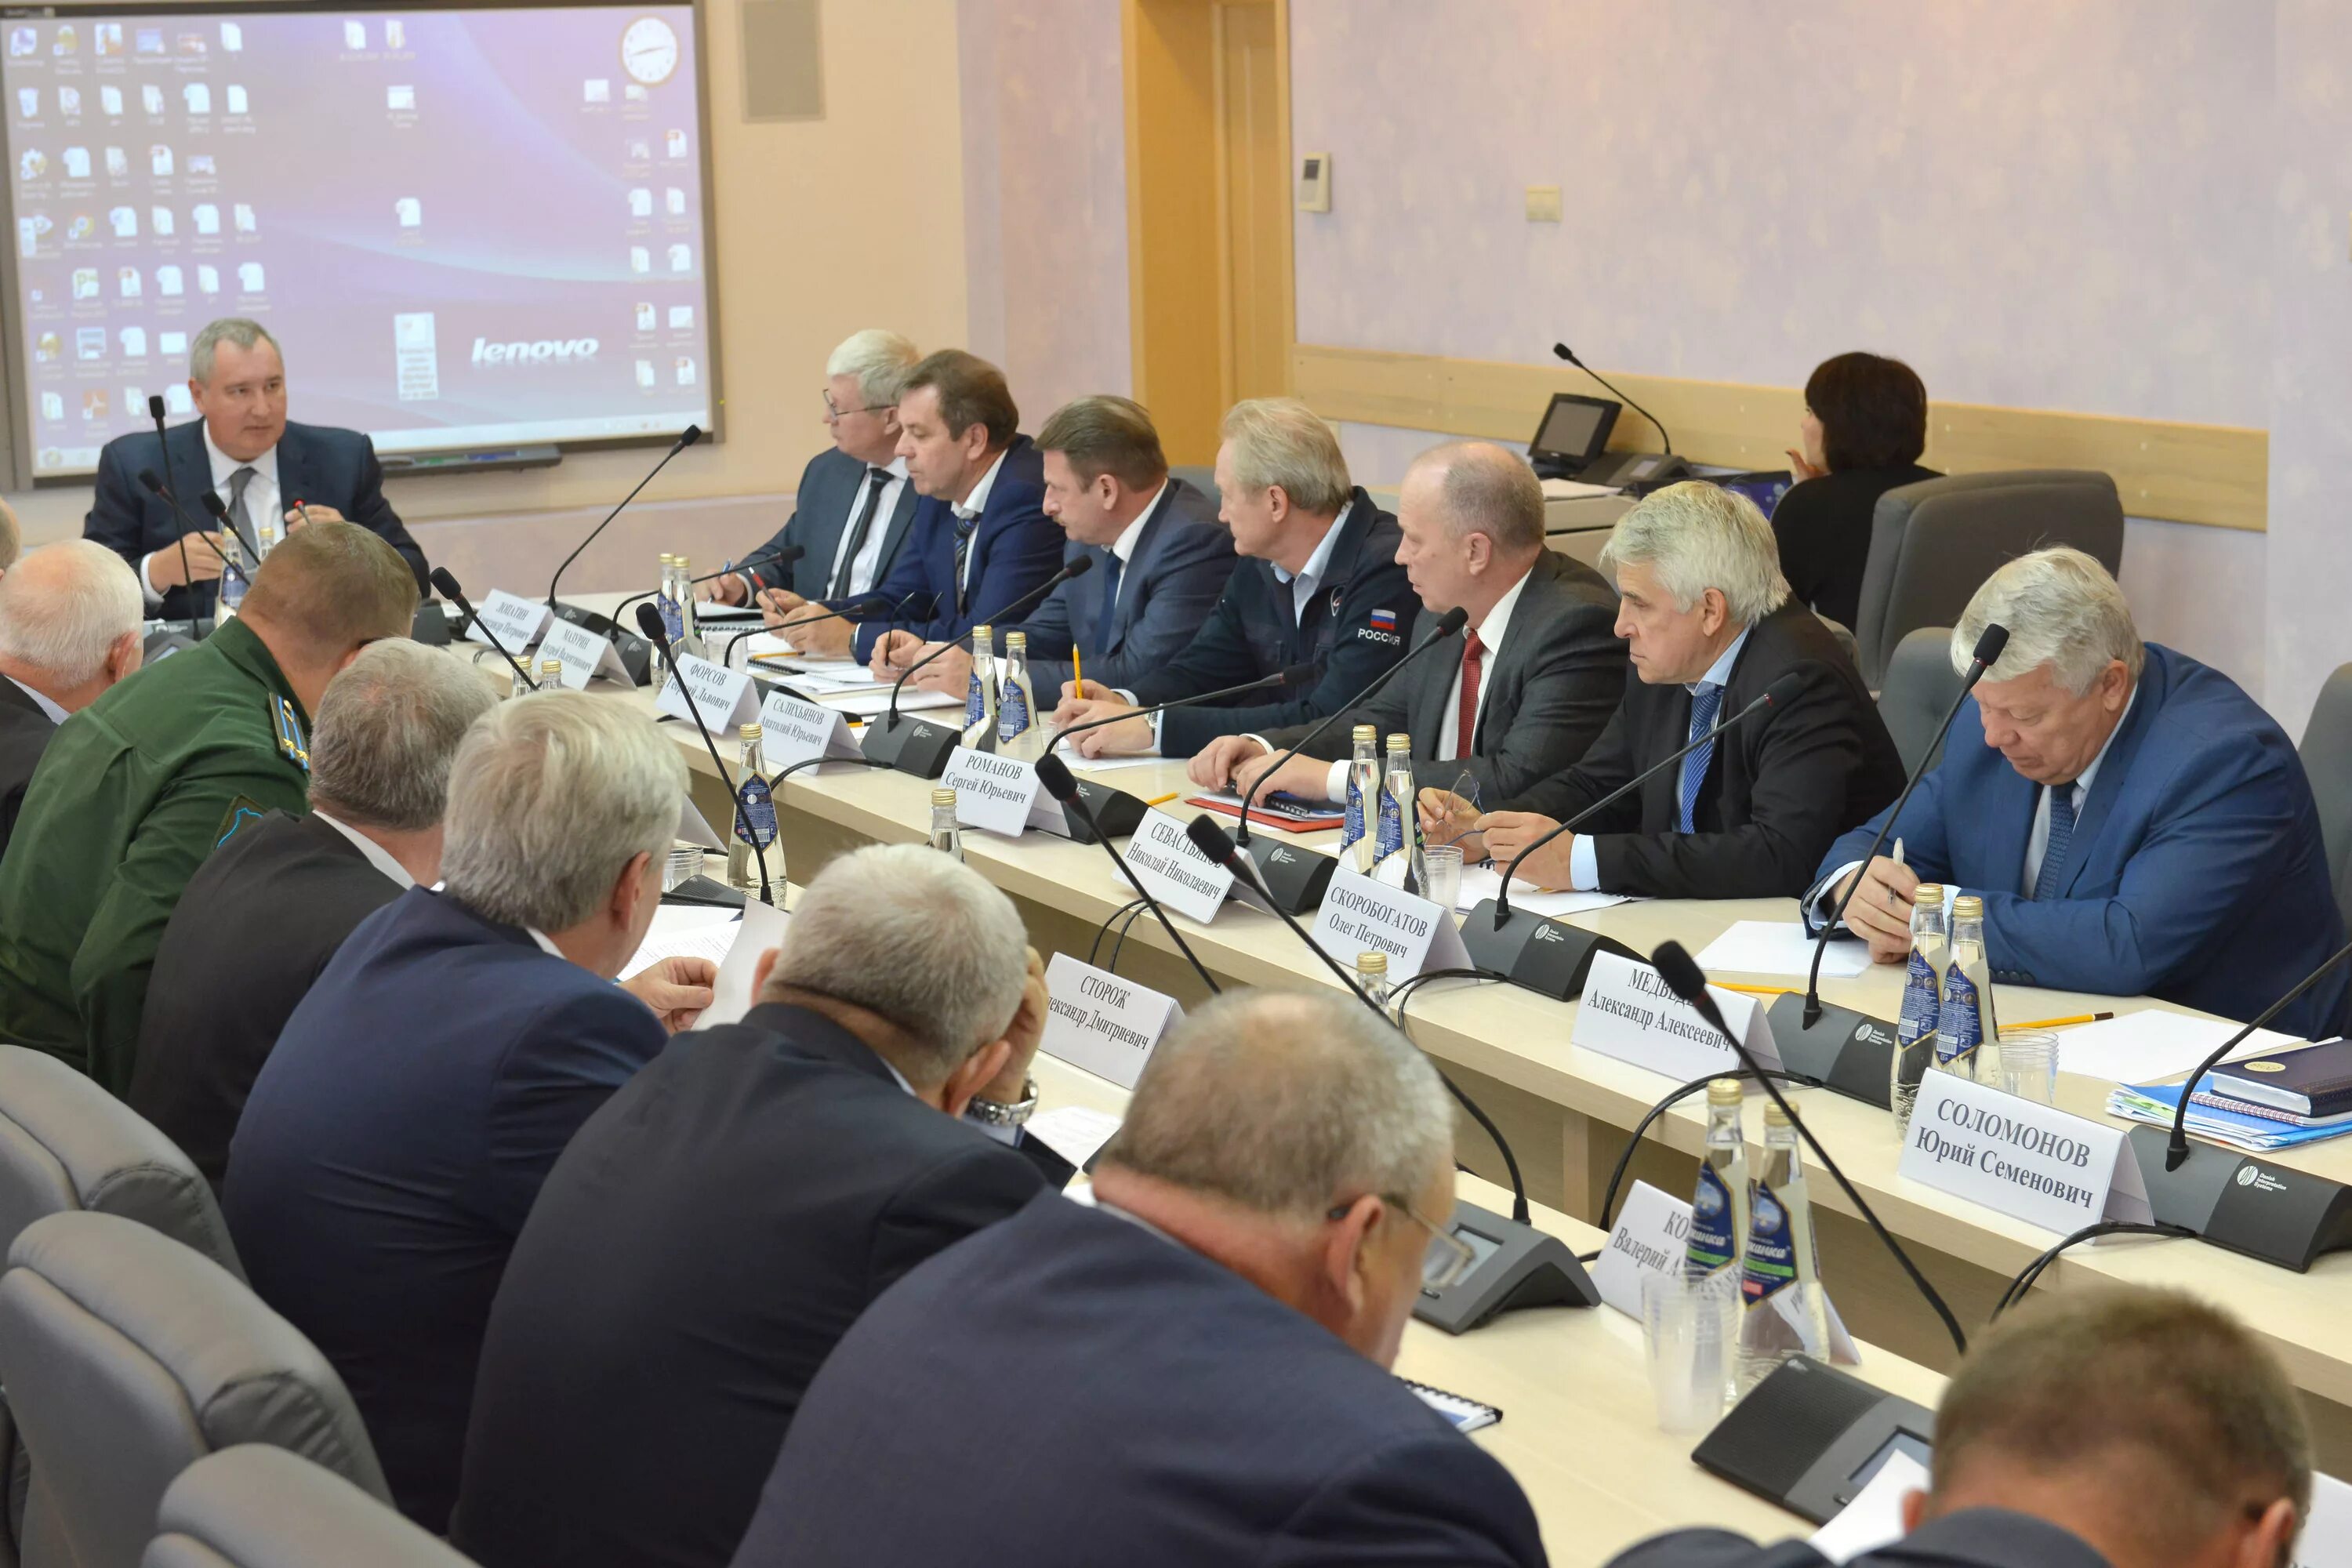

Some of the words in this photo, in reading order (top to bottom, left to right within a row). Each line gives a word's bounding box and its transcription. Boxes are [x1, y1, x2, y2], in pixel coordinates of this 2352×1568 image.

[471, 337, 599, 362] lenovo
[1357, 628, 1401, 646] РОССИЯ
[666, 676, 698, 698] Георий
[695, 687, 730, 710] Львович
[690, 663, 728, 686] ФОРСОВ
[760, 715, 793, 735] Анатолий
[790, 724, 822, 746] Юрьевич
[946, 771, 979, 790] Сергей
[978, 779, 1026, 804] Юрьевич
[966, 755, 1022, 779] РОМАНОВ
[1151, 822, 1222, 869] СЕВАСТЬ
[1126, 842, 1169, 874] Николай
[1164, 859, 1221, 900] Николаевич
[1330, 886, 1428, 938] СКОРОБОГАТОВ
[1329, 913, 1356, 936] Олег
[1354, 923, 1408, 959] Петрович
[1080, 975, 1131, 1009] СТОРОЖ
[1048, 995, 1088, 1029] лександр
[1085, 1009, 1149, 1051] Дмитриевич
[1587, 989, 1654, 1031] Александр
[1654, 1011, 1731, 1052] Алексеевич
[1936, 1098, 2091, 1168] СОЛОМОНОВ
[1915, 1126, 1976, 1168] Юрий
[1979, 1149, 2094, 1210] Семенович
[1613, 1226, 1671, 1271] Валерий
